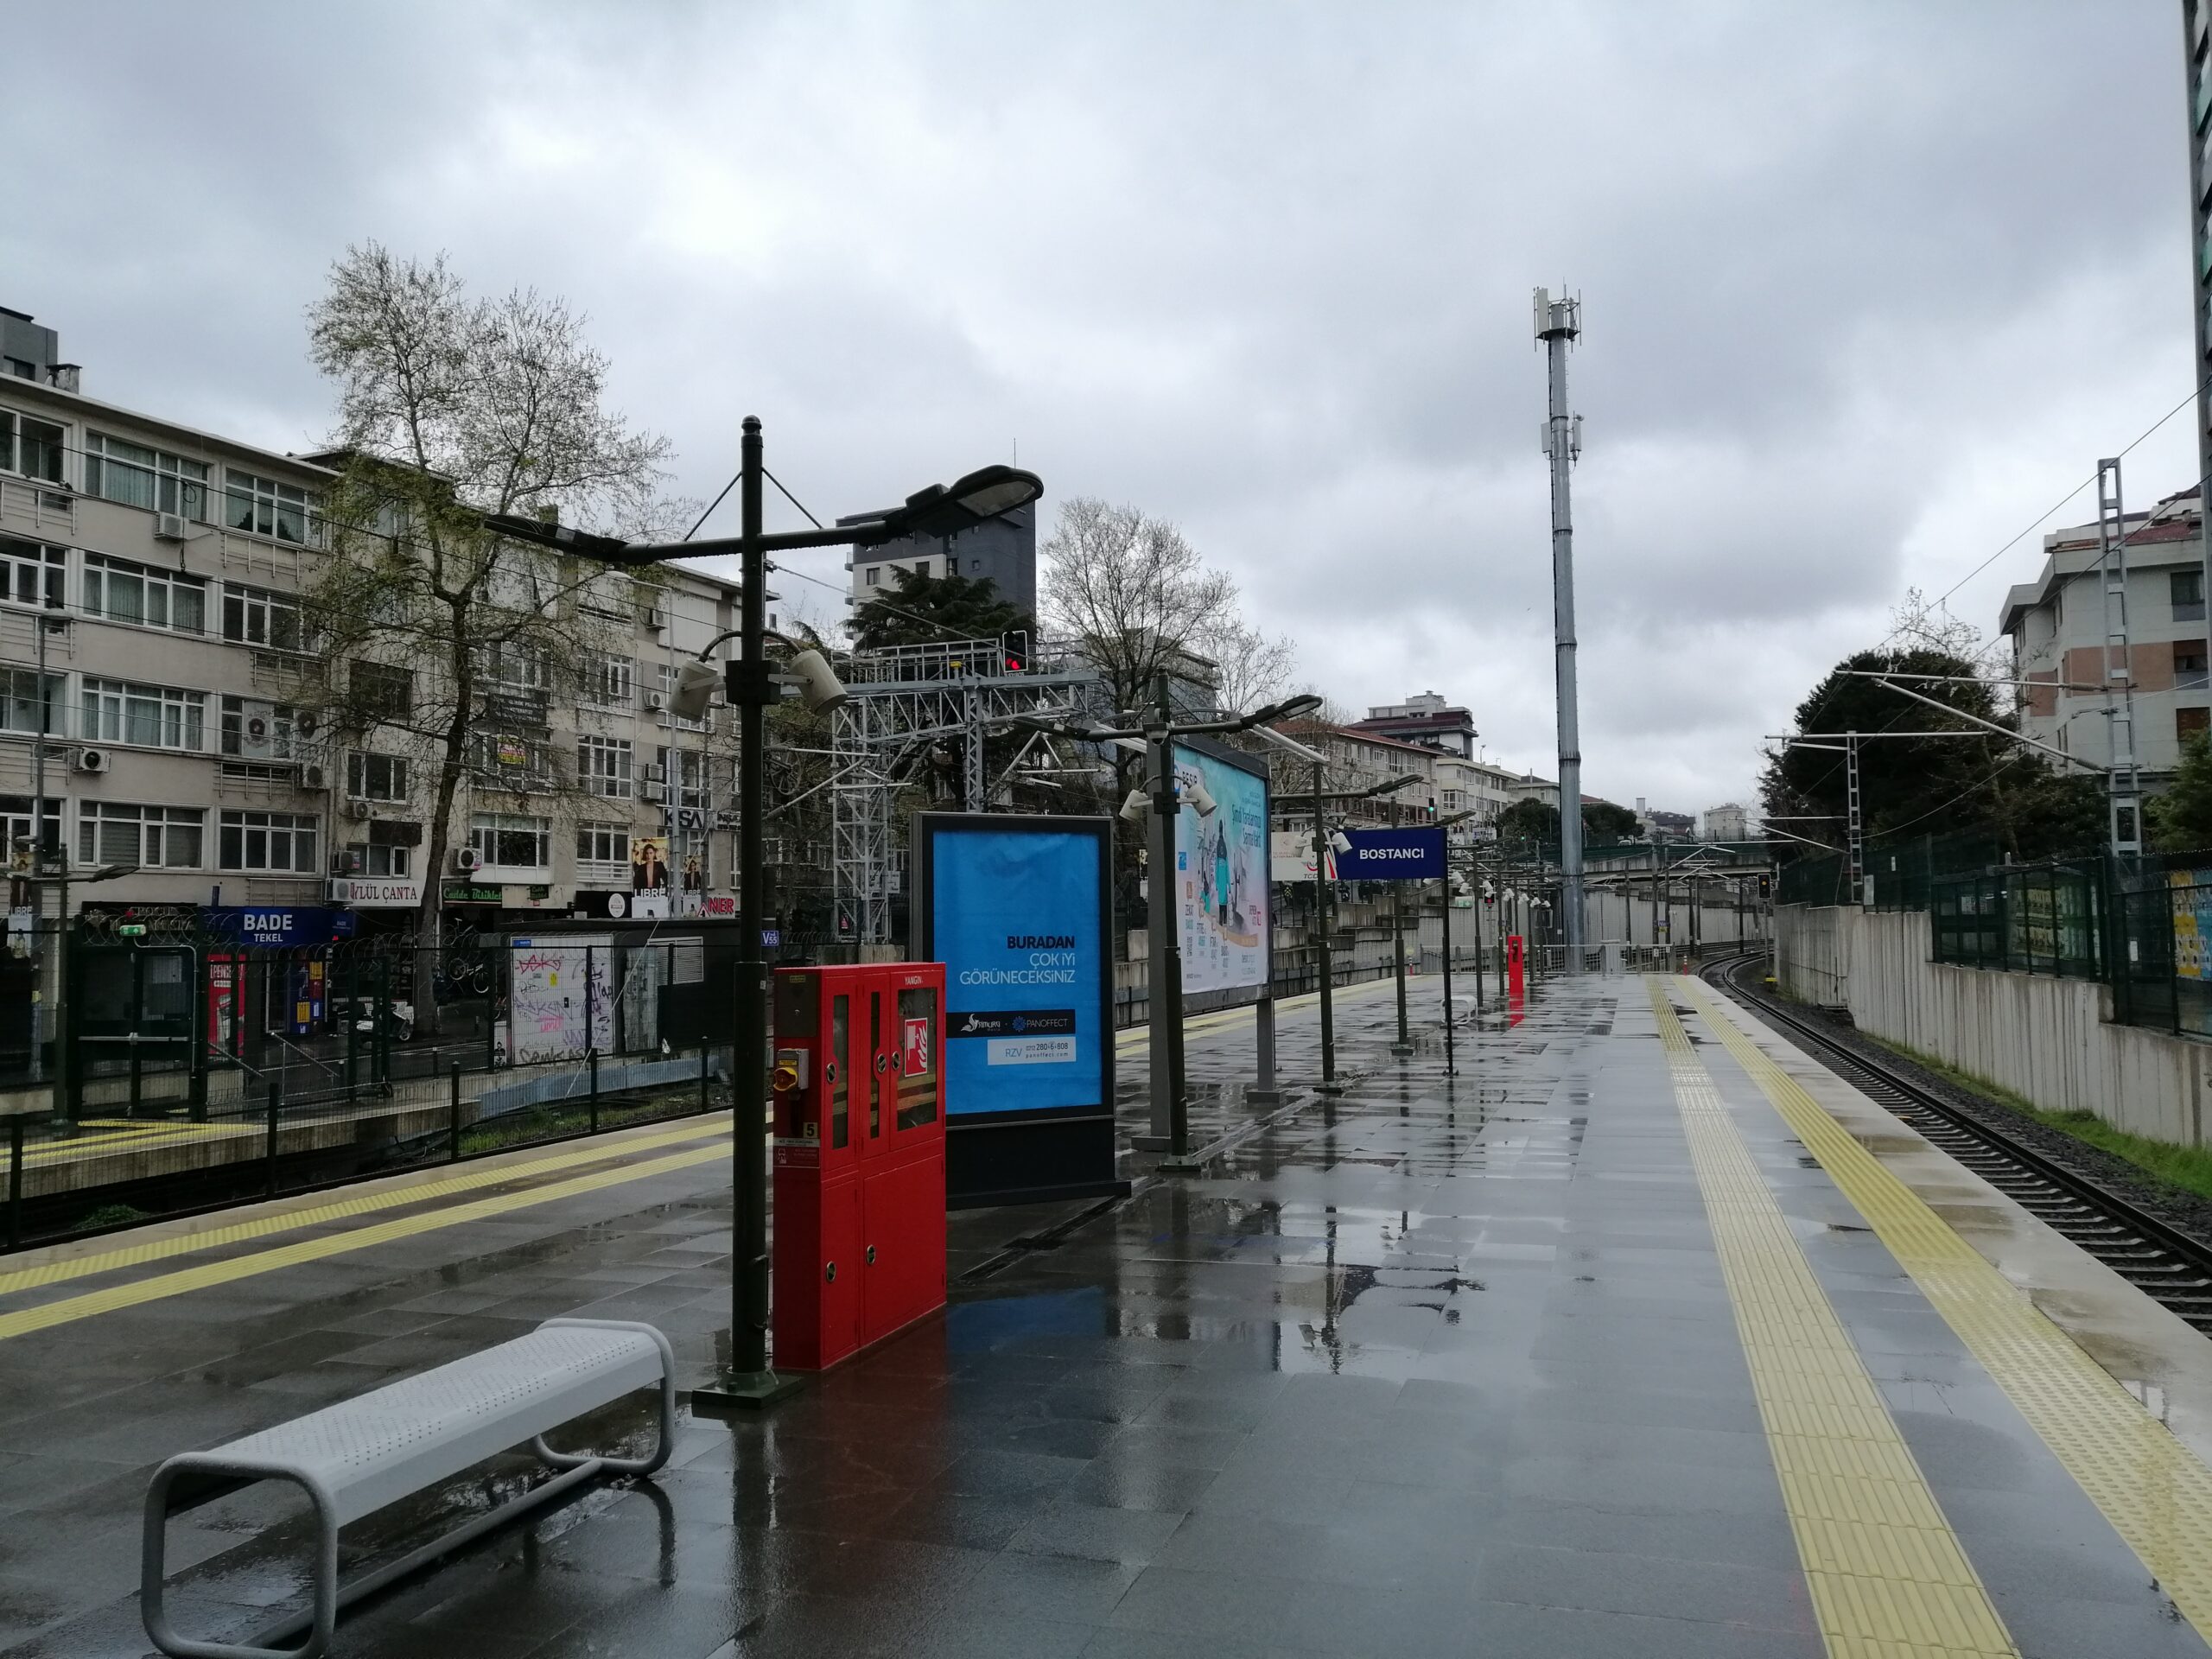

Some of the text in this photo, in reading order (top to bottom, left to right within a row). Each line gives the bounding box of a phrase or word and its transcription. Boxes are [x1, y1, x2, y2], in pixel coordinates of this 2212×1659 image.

[1359, 848, 1425, 860] BOSTANCI
[382, 887, 417, 904] ÇANTA
[442, 887, 469, 899] Cadde
[634, 887, 666, 898] LIBRE
[10, 905, 33, 916] LIBRE
[243, 913, 293, 931] BADE
[253, 933, 283, 943] TEKEL
[1007, 935, 1075, 950] BURADAN
[1029, 952, 1059, 969] ÇOK
[1026, 1018, 1069, 1028] PANOFFECT
[1005, 1047, 1023, 1058] RZV
[806, 1124, 815, 1137] 5
